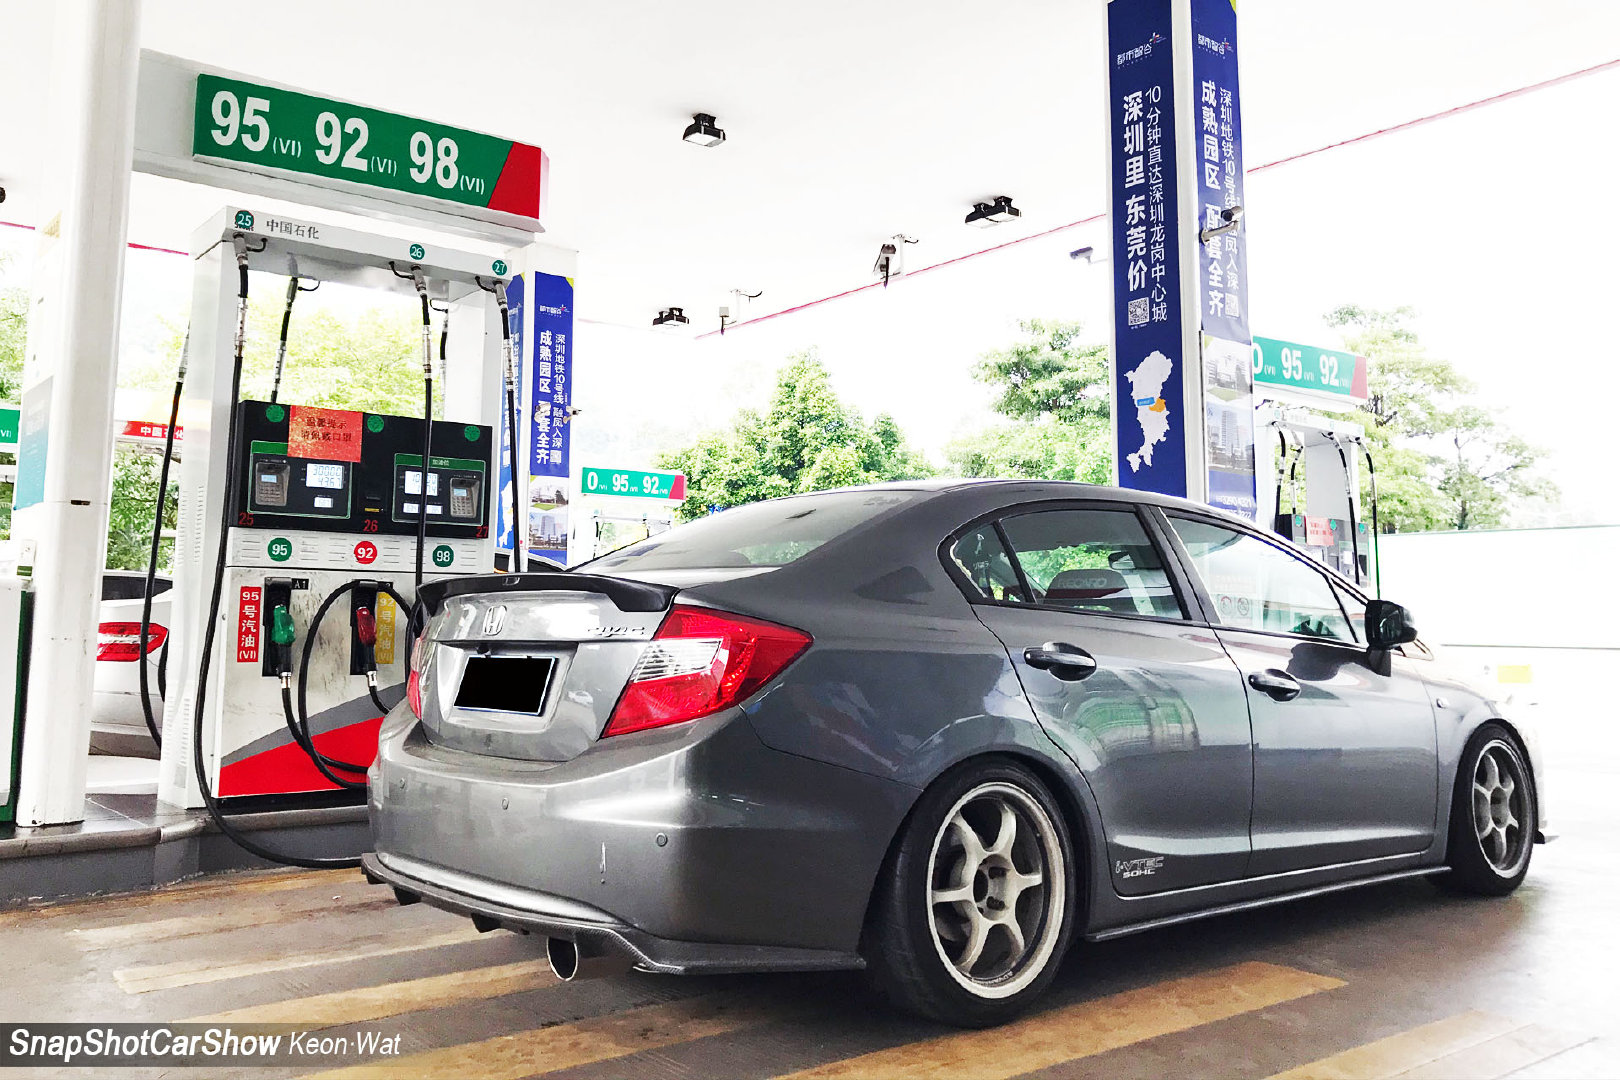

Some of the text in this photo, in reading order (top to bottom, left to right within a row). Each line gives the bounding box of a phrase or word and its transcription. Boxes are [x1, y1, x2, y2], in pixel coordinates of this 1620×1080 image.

[211, 90, 270, 152] 95
[315, 111, 369, 172] 92
[409, 131, 459, 189] 98
[1123, 91, 1145, 189] 深圳里
[1201, 80, 1221, 190] 成熟园区
[238, 213, 252, 227] 25
[266, 219, 319, 239] 中国石化
[1125, 194, 1148, 292] 东莞价
[410, 246, 423, 258] 26
[494, 262, 506, 274] 27
[1281, 347, 1302, 380] 95
[1320, 354, 1339, 387] 92
[587, 472, 598, 490] 0
[612, 473, 629, 492] 95
[642, 476, 660, 495] 92
[239, 512, 254, 527] 25
[363, 519, 379, 532] 26
[476, 526, 489, 538] 27
[271, 543, 288, 556] 95
[357, 547, 374, 559] 92
[436, 550, 450, 562] 98
[1122, 868, 1156, 878] SOHC
